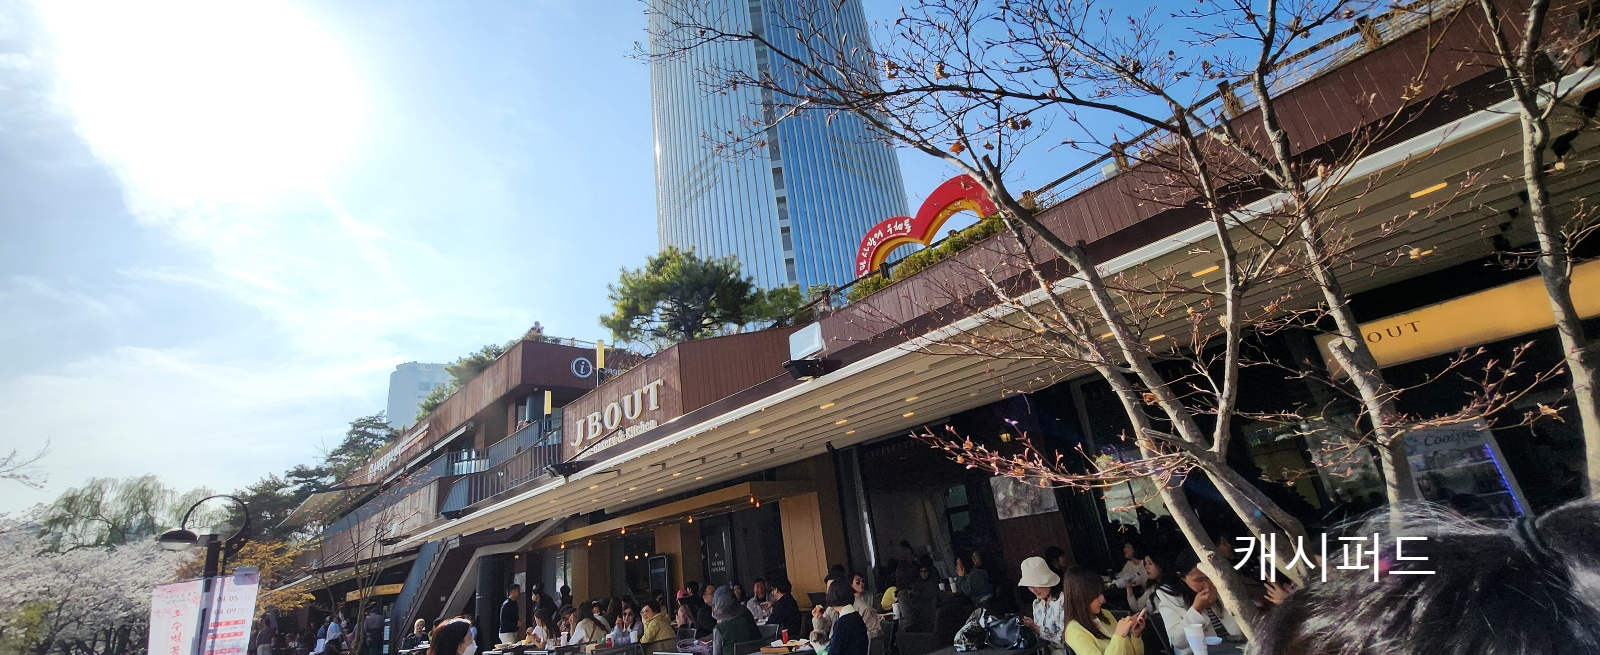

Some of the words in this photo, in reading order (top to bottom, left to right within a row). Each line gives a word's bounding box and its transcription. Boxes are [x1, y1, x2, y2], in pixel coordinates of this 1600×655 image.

[861, 229, 884, 258] 사랑의
[886, 218, 912, 235] 우체통
[570, 378, 664, 447] JBOUT
[625, 419, 658, 440] Kitchen
